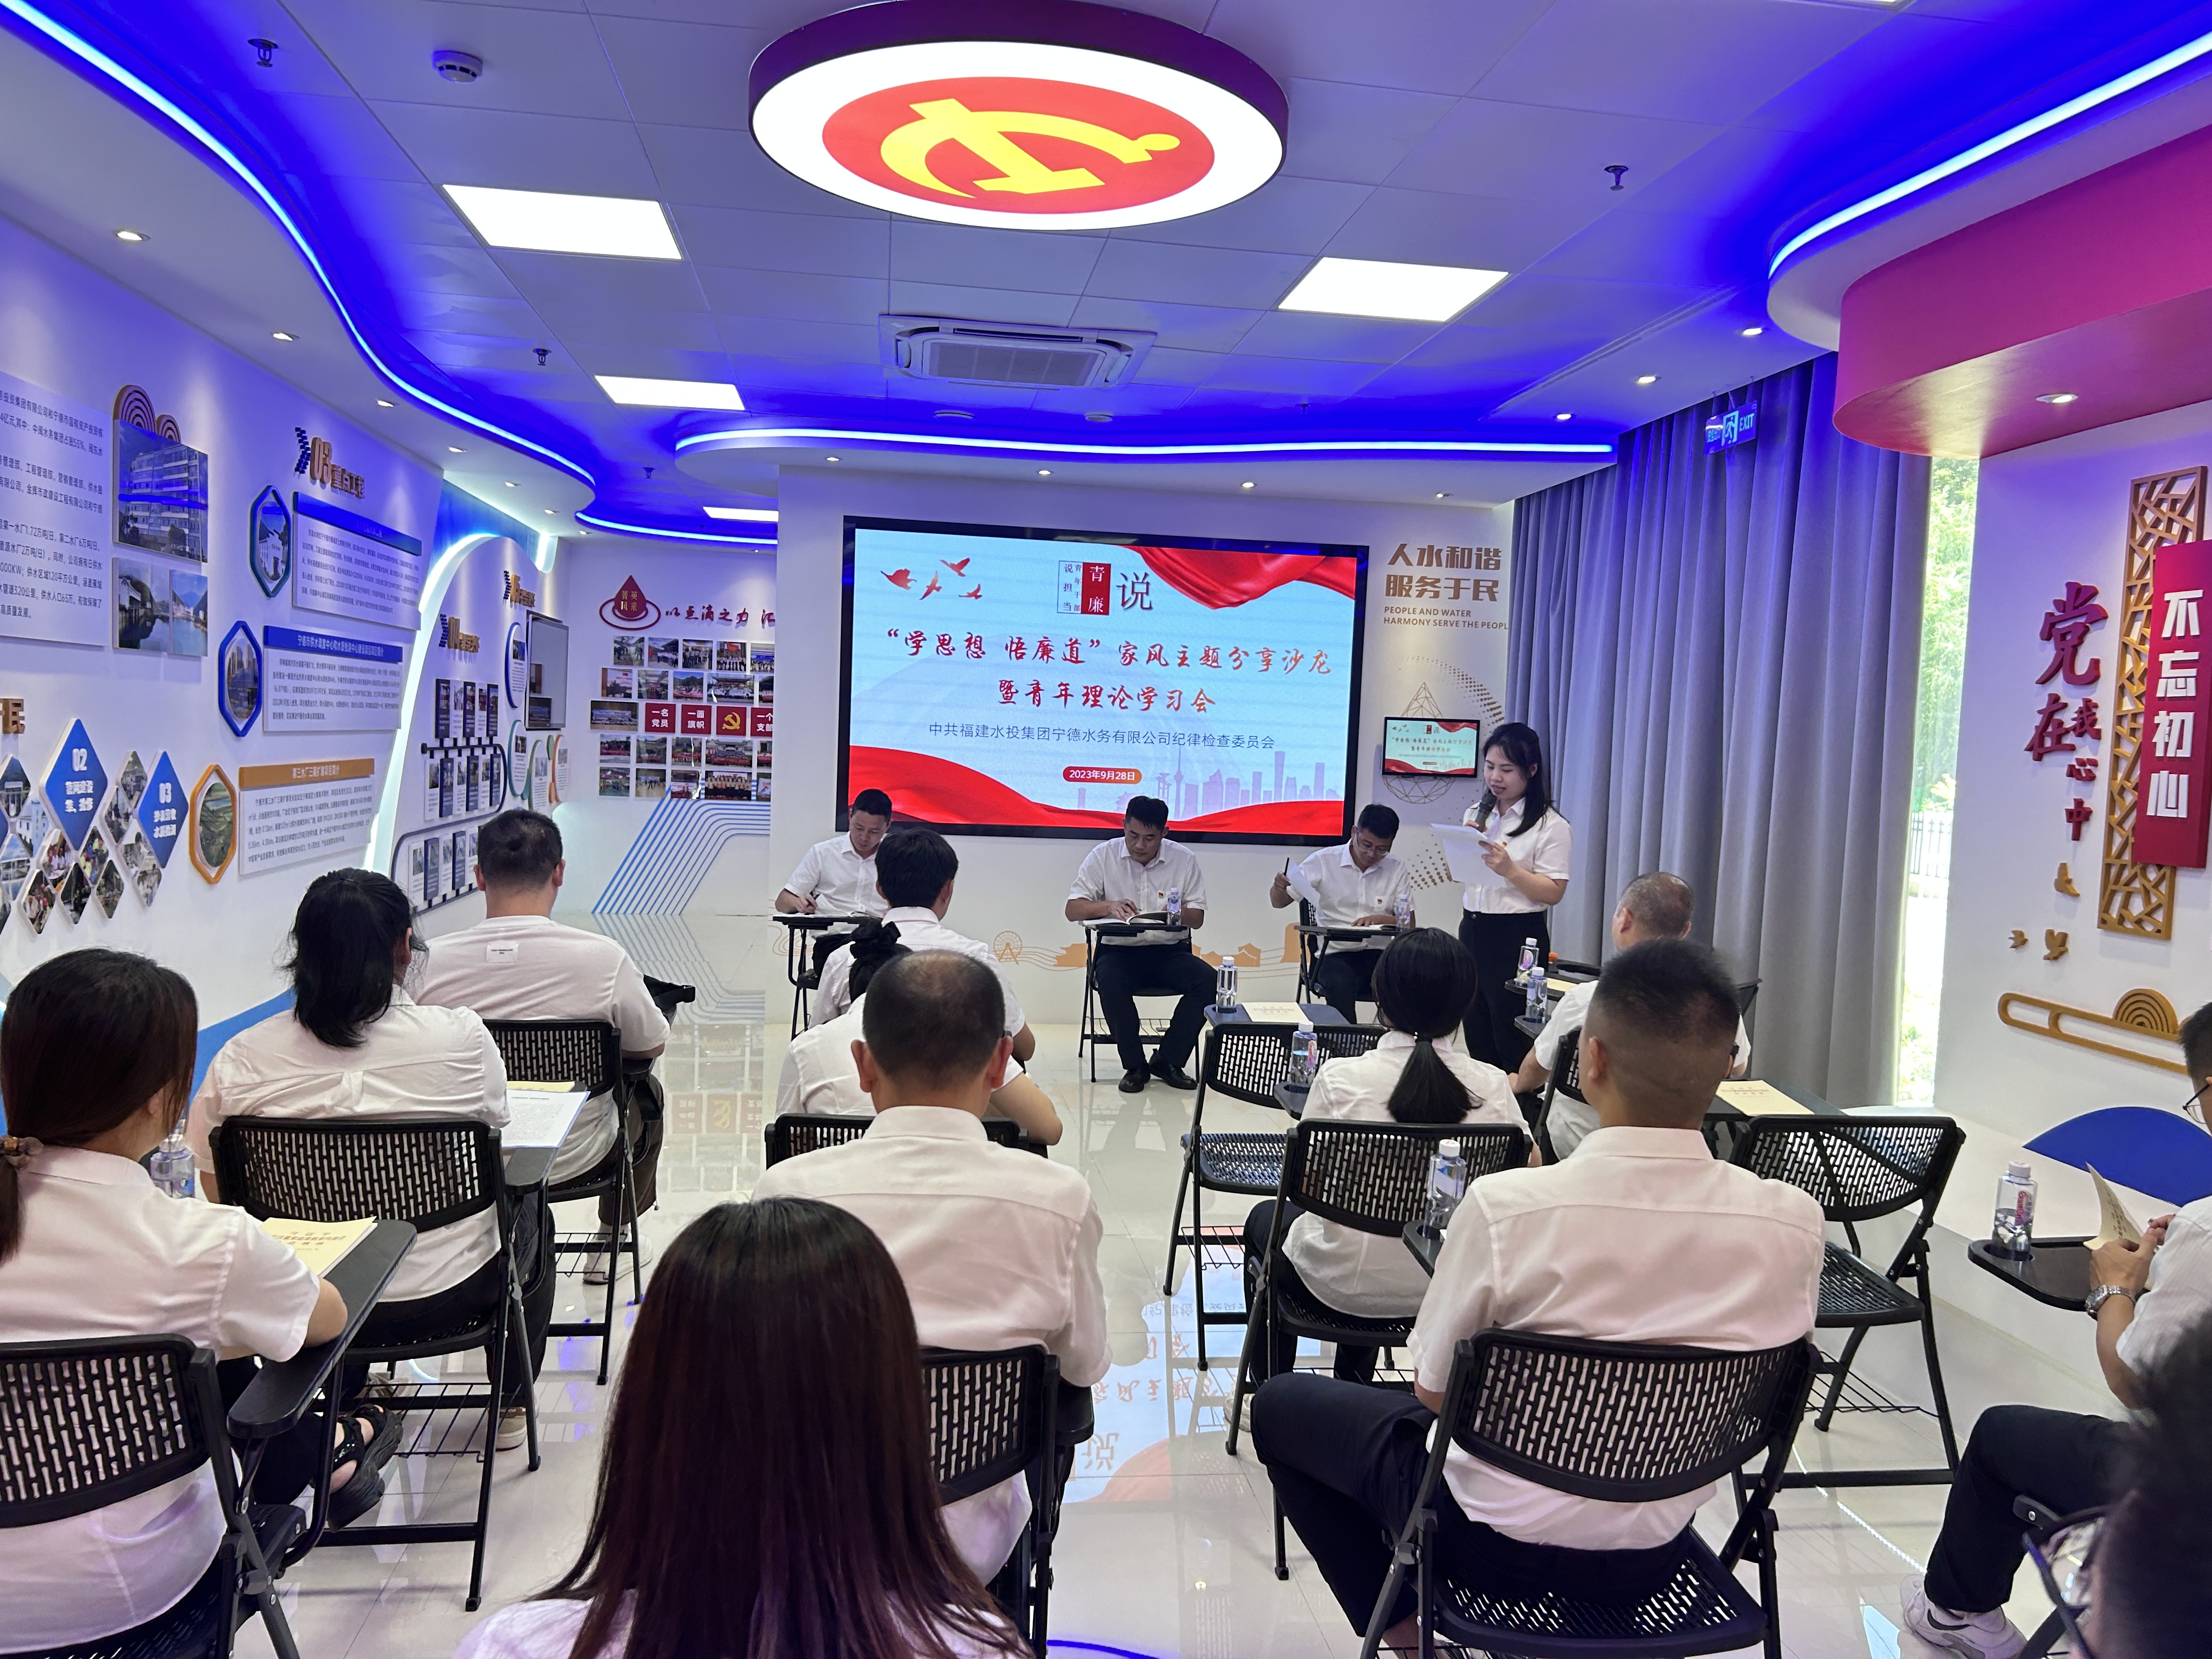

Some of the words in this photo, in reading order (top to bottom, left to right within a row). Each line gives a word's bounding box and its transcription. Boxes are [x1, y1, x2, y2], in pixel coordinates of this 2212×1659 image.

[1739, 413, 1754, 431] EXIT
[1387, 544, 1502, 571] 人水和谐
[1088, 565, 1105, 613] 青廉
[1116, 572, 1153, 611] 说
[1385, 574, 1499, 602] 服务于民
[665, 604, 749, 624] 以点滴之力
[1384, 606, 1417, 615] PEOPLE
[1441, 609, 1471, 617] WATER
[1384, 617, 1431, 626] HARMONY
[1433, 619, 1459, 628] SERVE
[1119, 640, 1331, 674] 家风主题分享沙龙
[998, 679, 1215, 713] 暨青年理论学习会
[2147, 589, 2203, 818] 不忘初心
[652, 708, 669, 717] 一名
[687, 710, 704, 718] 一面
[2024, 582, 2108, 840] 党在我心中
[652, 719, 668, 727] 党员
[687, 720, 704, 729] 旗帜
[929, 722, 1275, 749] 中共福建水投集团宁德水务有限公司纪律检查委员会
[72, 748, 87, 771] 02
[1069, 769, 1135, 781] 2023年9月28日
[159, 782, 172, 803] 03
